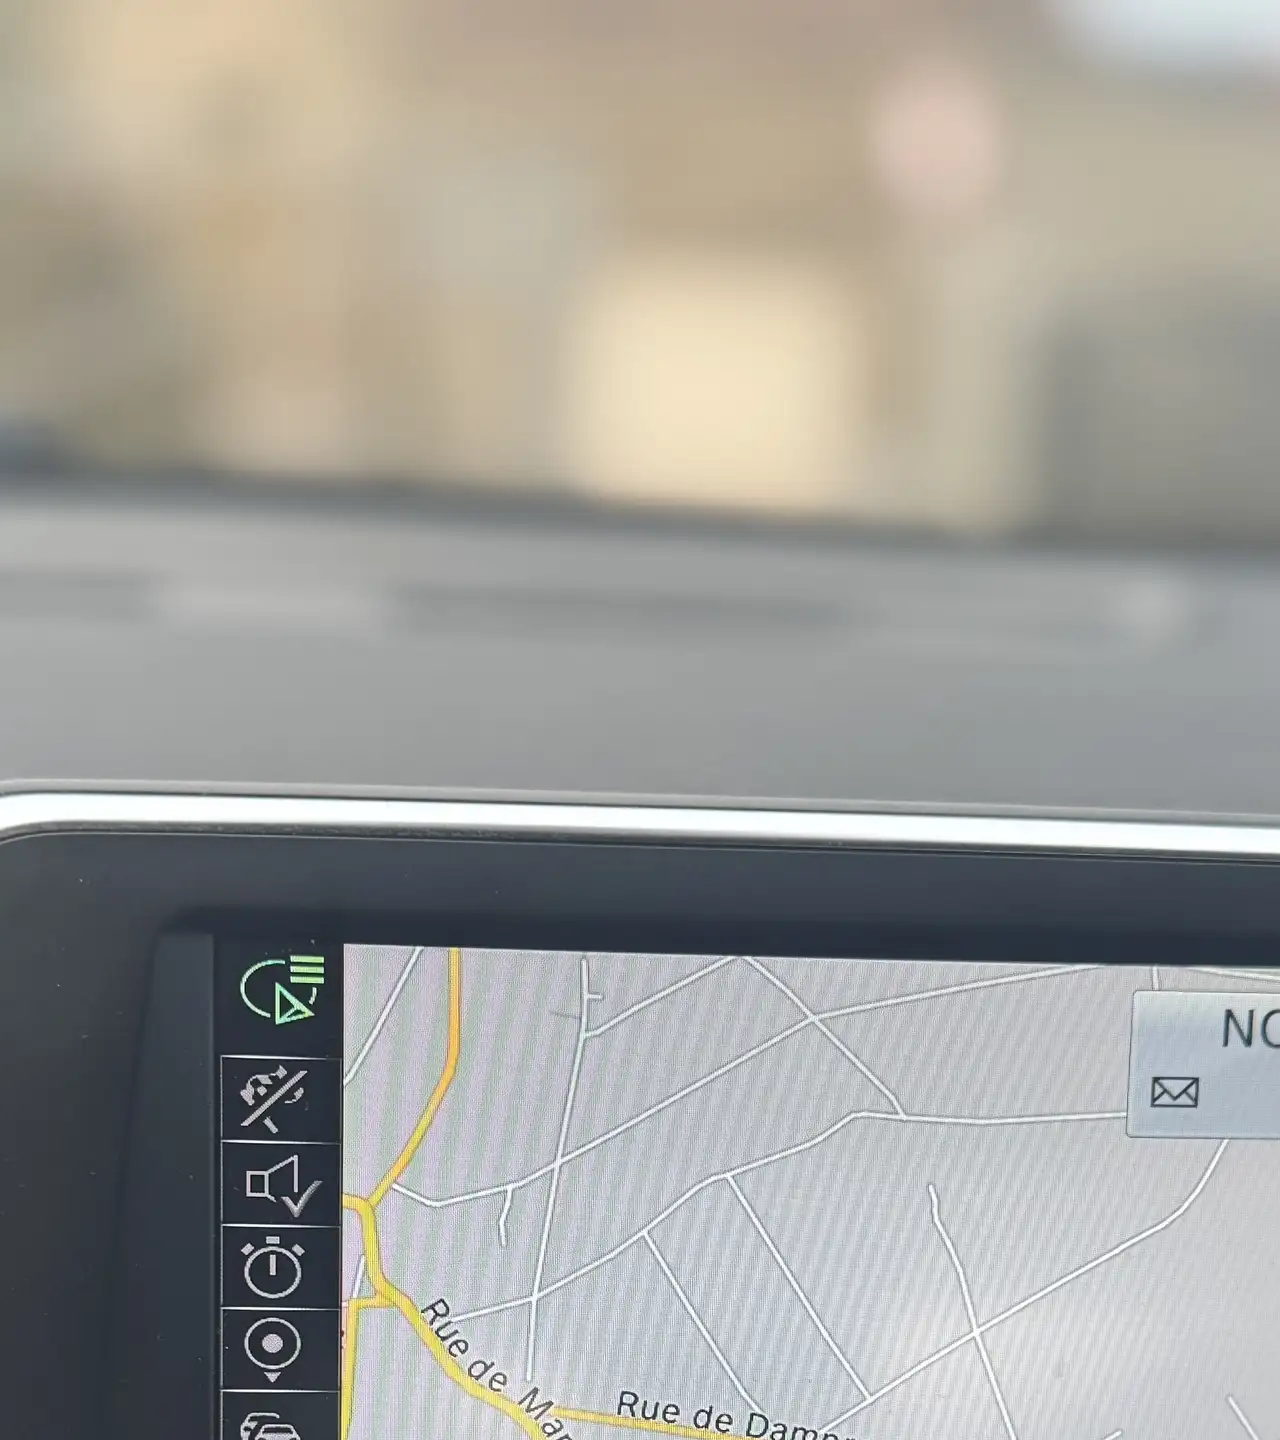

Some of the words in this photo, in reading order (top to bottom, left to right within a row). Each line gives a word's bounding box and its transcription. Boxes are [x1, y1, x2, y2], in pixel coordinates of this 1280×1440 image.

[420, 1298, 469, 1357] Rue
[467, 1359, 508, 1392] de
[616, 1390, 681, 1423] Rue
[693, 1404, 733, 1434] de
